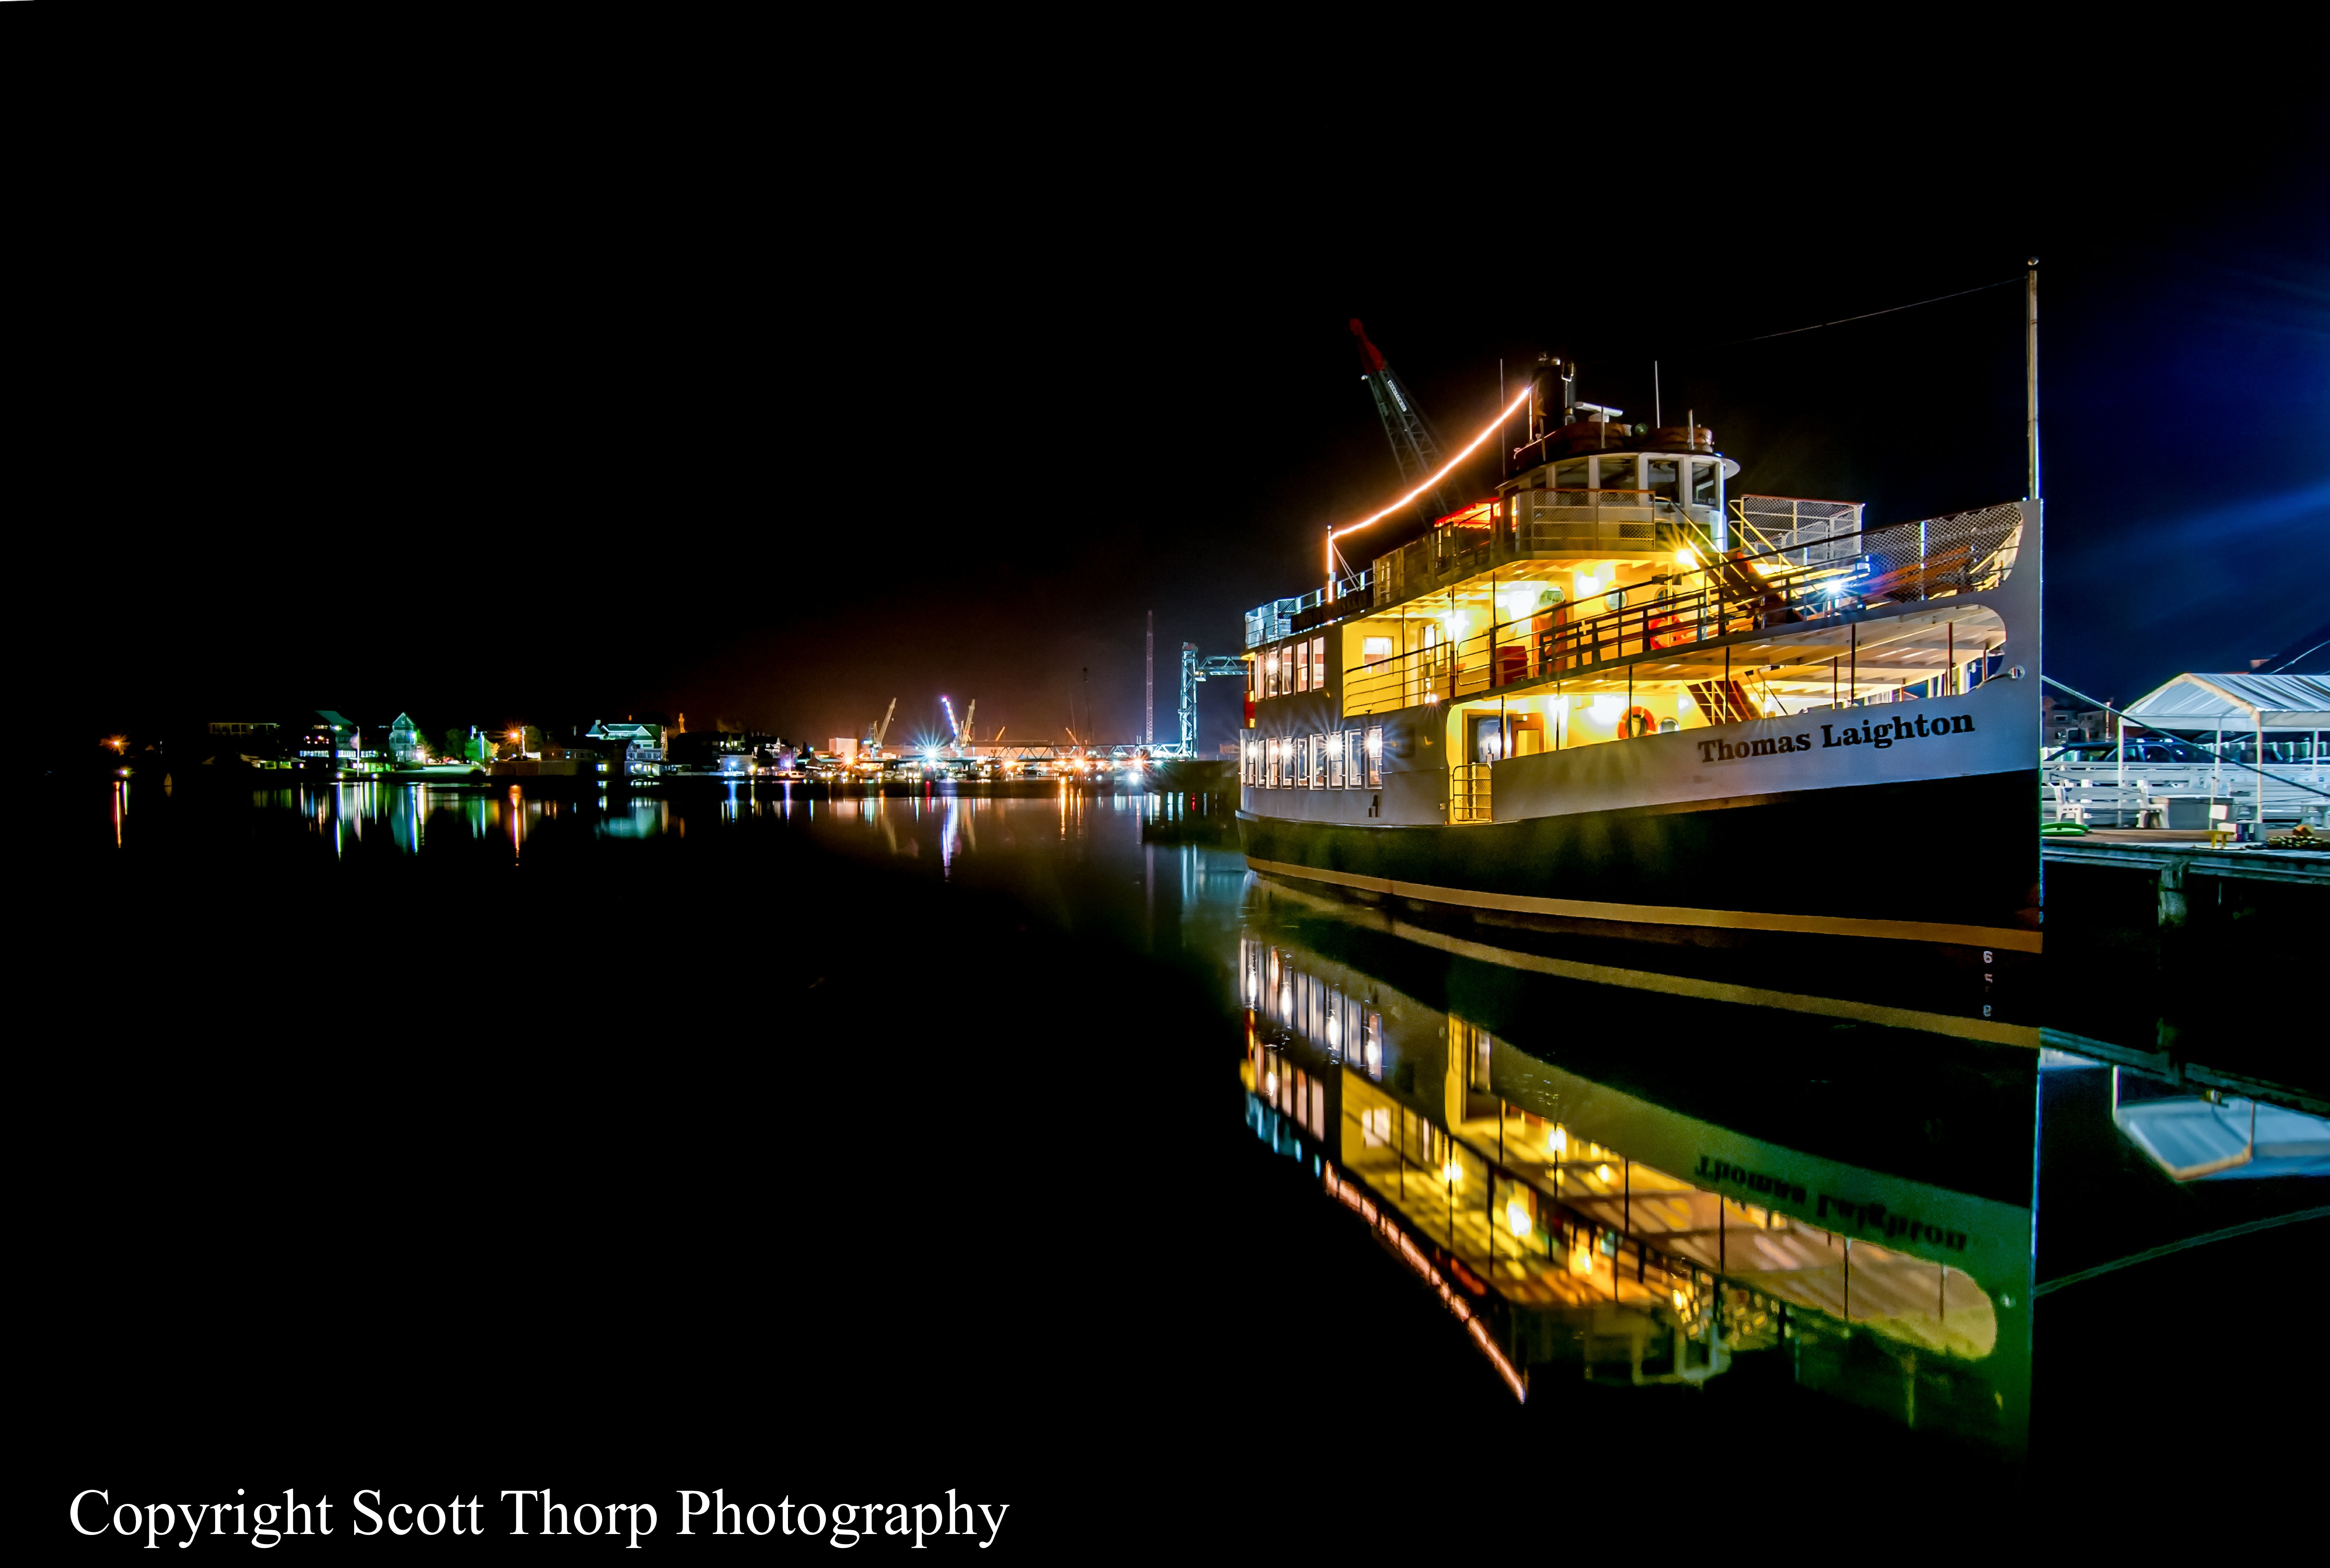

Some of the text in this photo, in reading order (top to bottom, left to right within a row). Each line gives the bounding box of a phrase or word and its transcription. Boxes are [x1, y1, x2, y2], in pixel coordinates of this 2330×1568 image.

[1698, 714, 1975, 763] Thomas Laighton
[1983, 951, 1993, 963] 6
